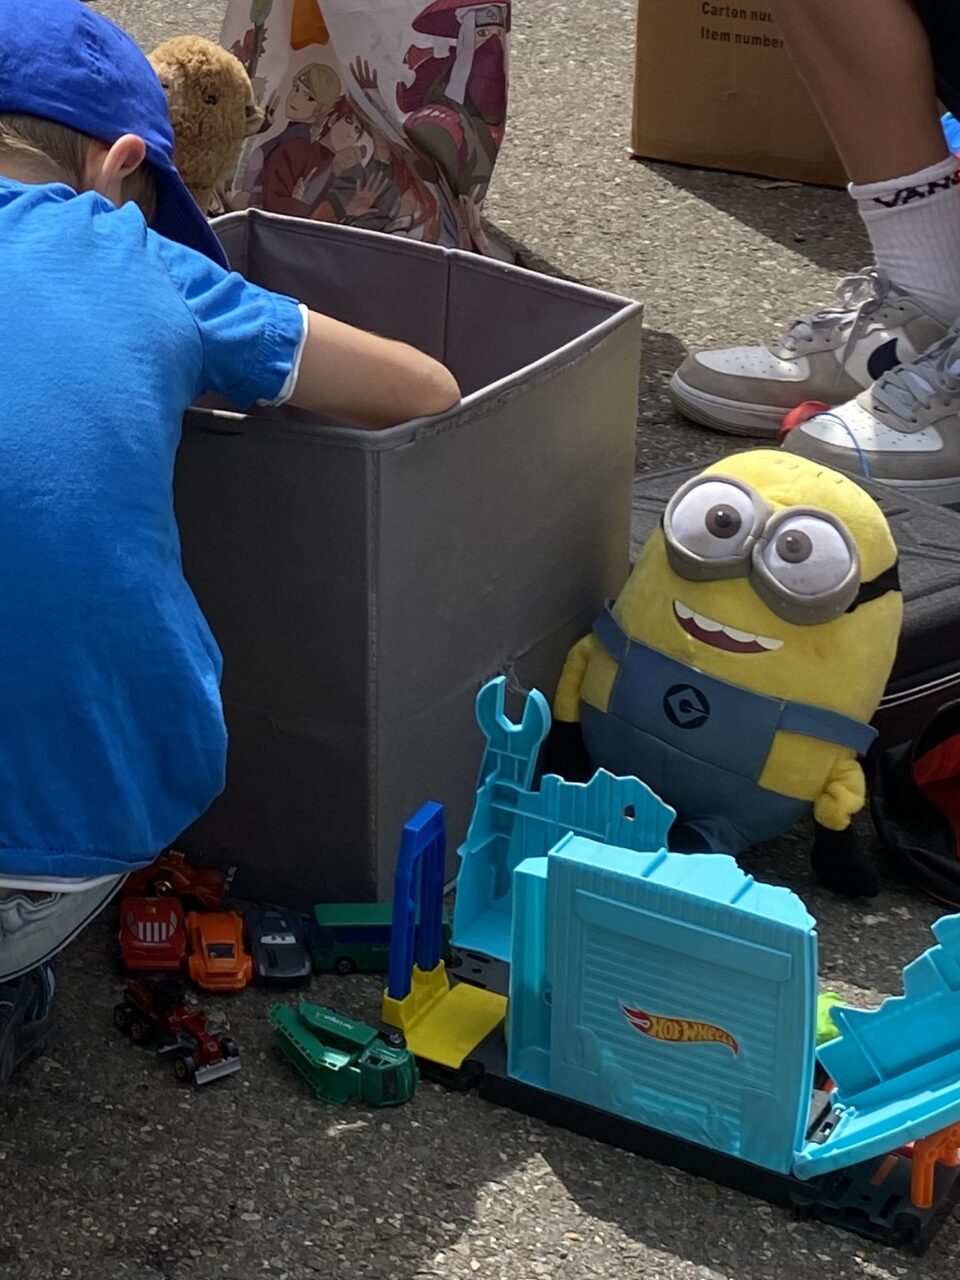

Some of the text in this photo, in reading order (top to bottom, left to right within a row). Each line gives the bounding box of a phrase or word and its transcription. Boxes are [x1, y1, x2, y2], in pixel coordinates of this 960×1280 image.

[701, 1, 747, 20] Carton
[700, 26, 784, 49] Item number
[873, 174, 955, 208] VAN
[649, 1016, 681, 1041] HOT
